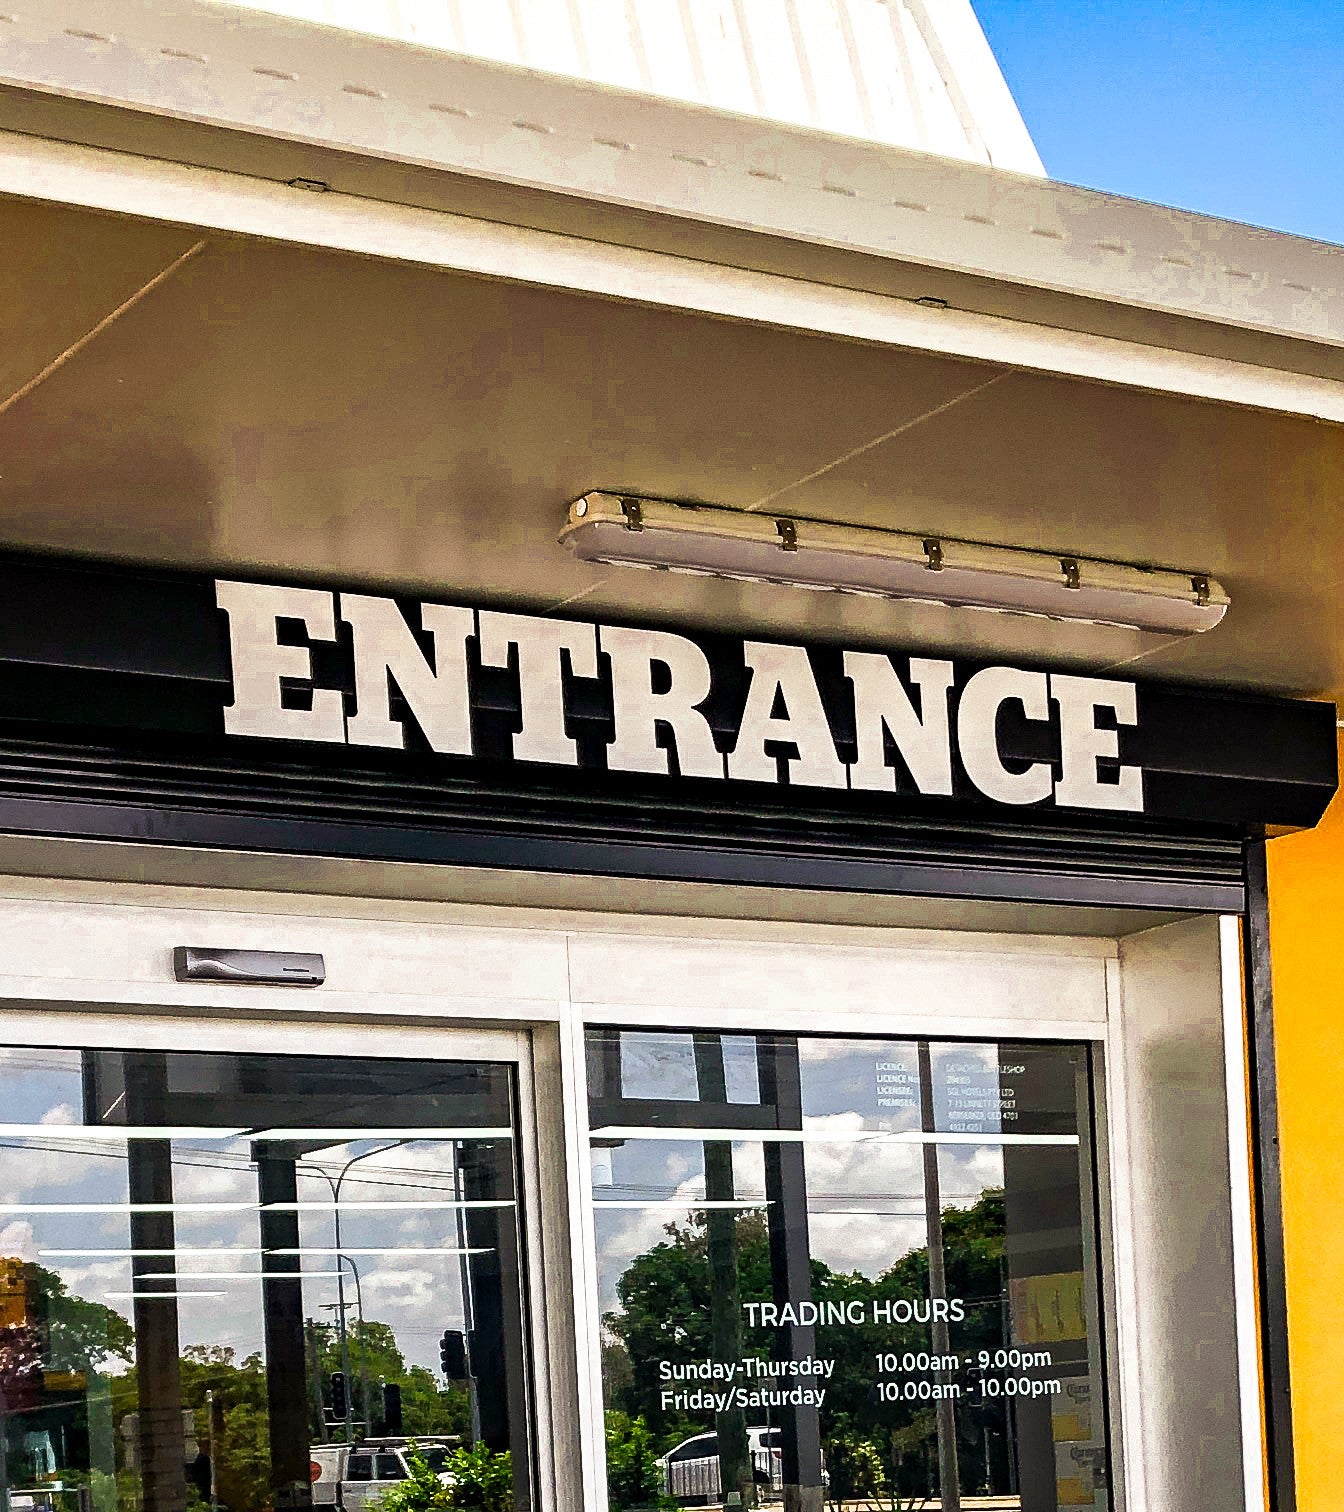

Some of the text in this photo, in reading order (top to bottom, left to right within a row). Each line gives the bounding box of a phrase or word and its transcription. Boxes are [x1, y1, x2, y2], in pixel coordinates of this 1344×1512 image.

[214, 578, 1146, 813] ENTRANCE
[743, 1298, 965, 1328] TRADING HOURS
[659, 1354, 835, 1382] Sunday-Thursday
[875, 1353, 959, 1374] 10.00am
[977, 1349, 1052, 1373] 9.00pm
[660, 1385, 826, 1412] Friday/Saturday
[877, 1382, 961, 1403] 10.00am
[979, 1377, 1062, 1401] 10.00pm
